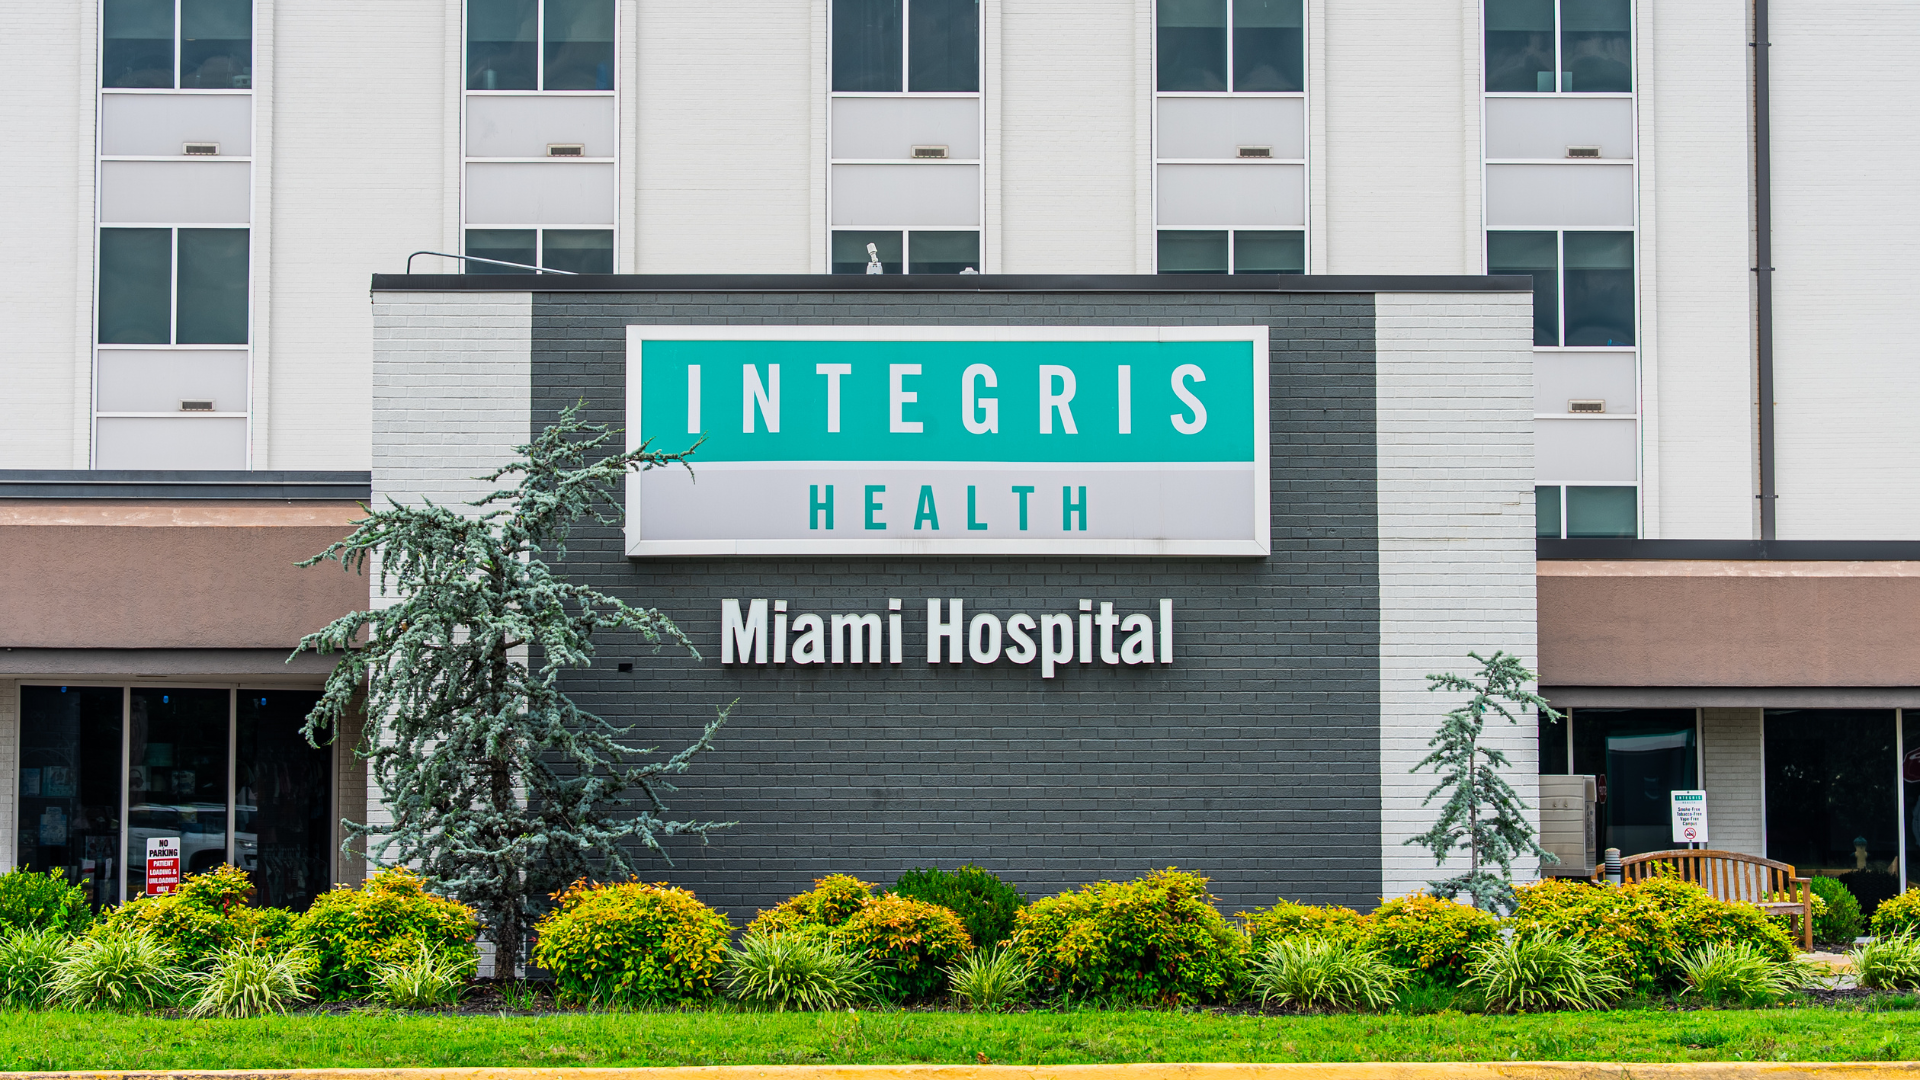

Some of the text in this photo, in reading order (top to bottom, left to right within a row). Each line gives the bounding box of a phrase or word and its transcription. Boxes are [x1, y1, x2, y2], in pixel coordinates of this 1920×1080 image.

[687, 363, 1208, 435] INTEGRIS
[809, 484, 1087, 531] HEALTH
[721, 598, 1173, 678] Miami Hospital
[149, 849, 178, 857] PARKING
